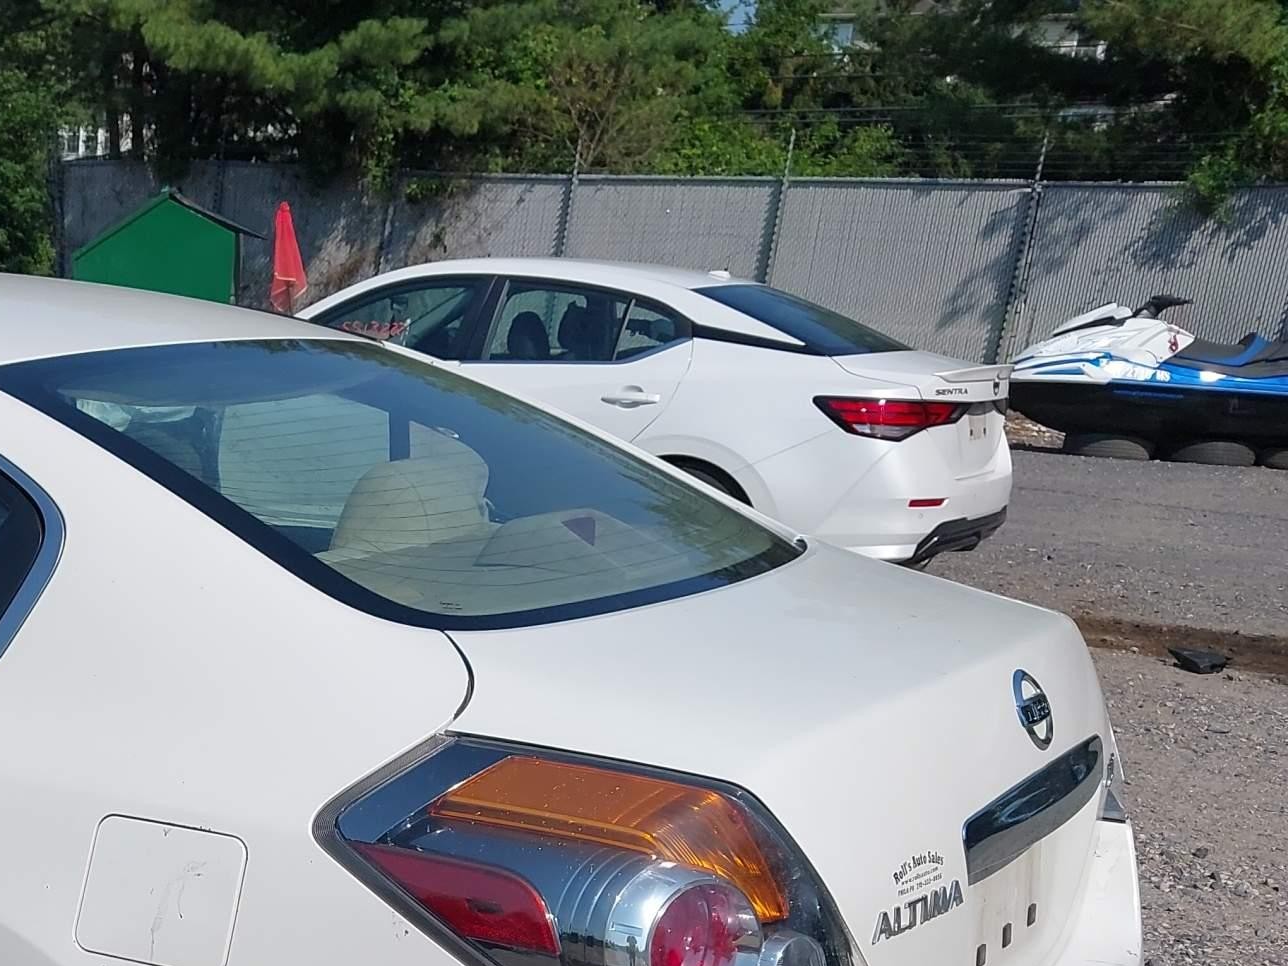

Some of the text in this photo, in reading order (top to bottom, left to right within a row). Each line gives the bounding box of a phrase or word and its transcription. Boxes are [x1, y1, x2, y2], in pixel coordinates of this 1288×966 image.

[935, 388, 968, 396] SENTRA
[912, 853, 927, 868] Auto
[927, 850, 944, 866] Sales
[872, 879, 964, 945] ALTIMA
